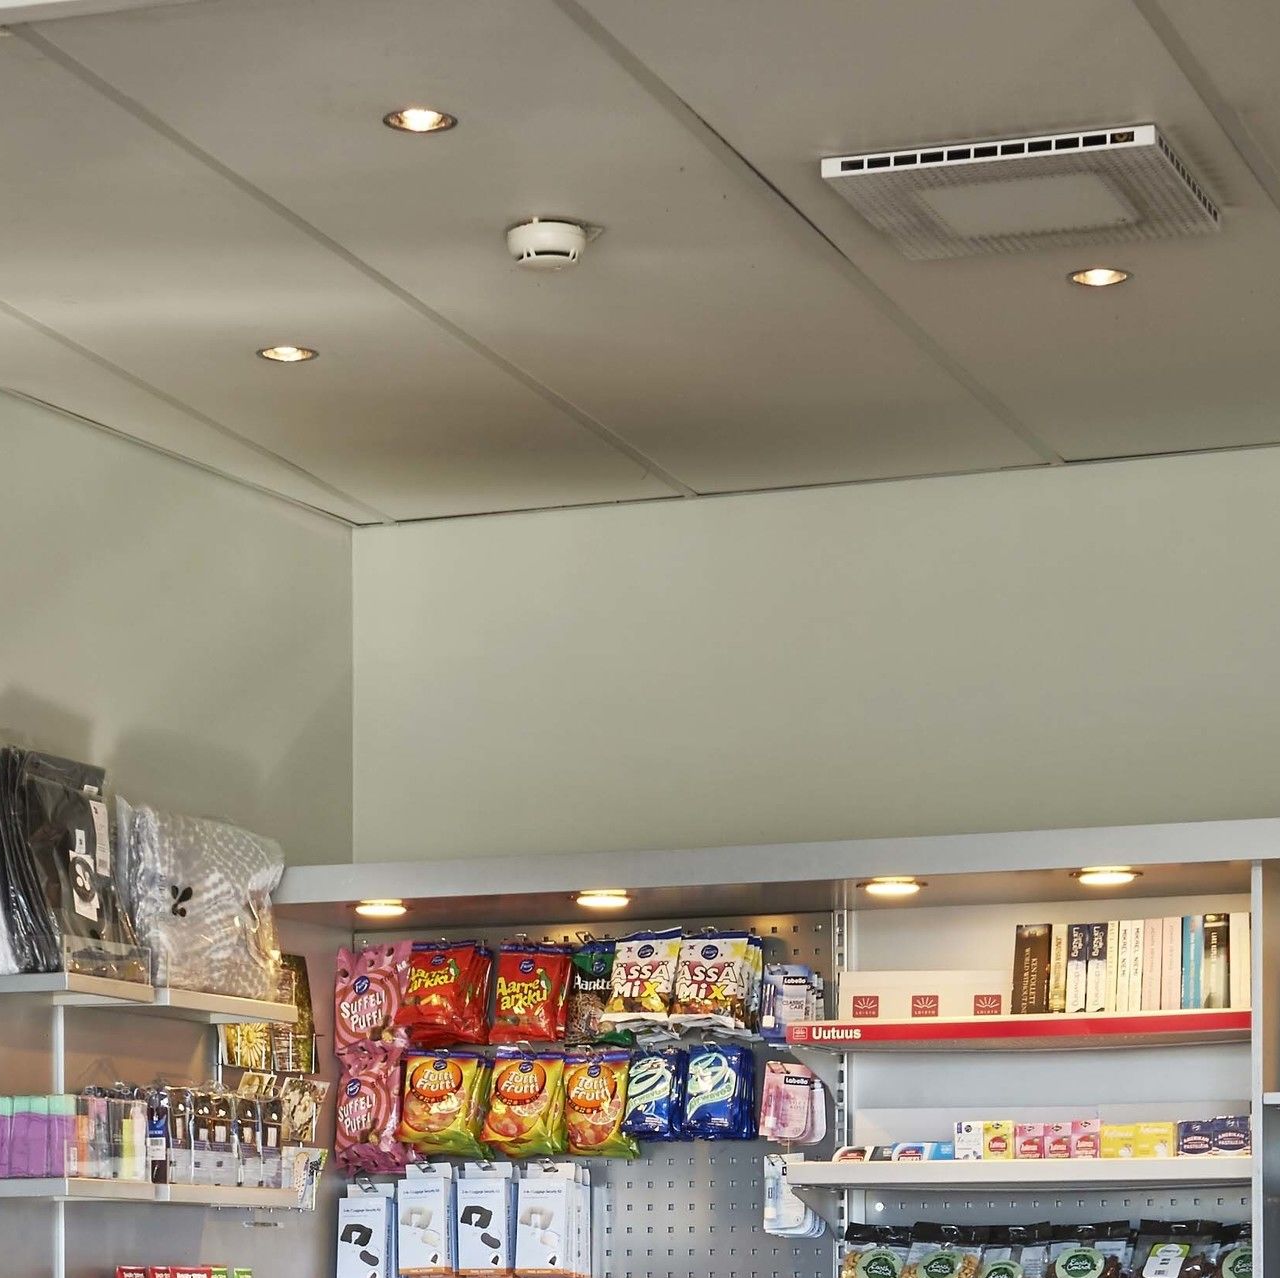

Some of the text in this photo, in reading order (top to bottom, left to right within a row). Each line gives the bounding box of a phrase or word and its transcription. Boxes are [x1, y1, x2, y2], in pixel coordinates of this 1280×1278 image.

[677, 962, 737, 982] ÄSSÄ
[496, 976, 540, 996] Aarre
[1029, 973, 1037, 1005] FOLLETT
[340, 992, 386, 1018] SUFFELI
[501, 988, 548, 1010] arkku
[812, 1026, 861, 1040] Uutuus
[417, 1078, 455, 1093] Frutti
[500, 1080, 539, 1095] Frutti
[338, 1094, 376, 1122] SUFFELI
